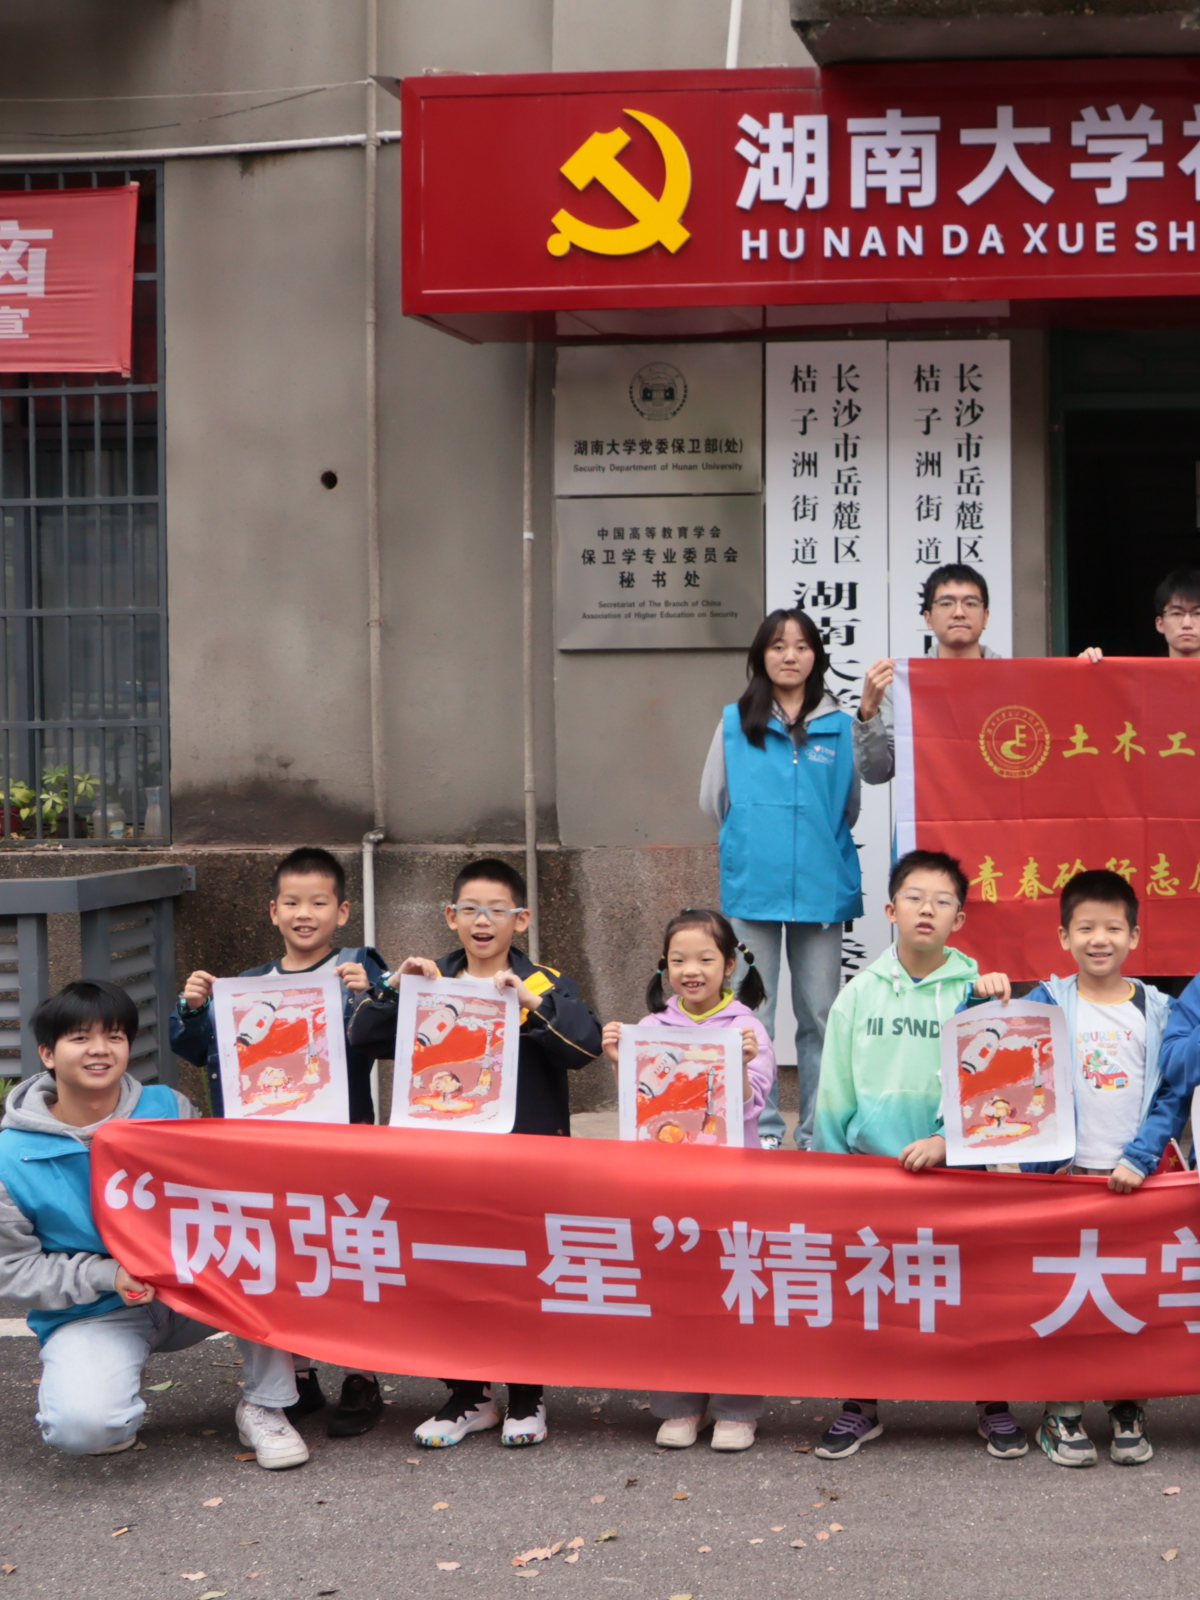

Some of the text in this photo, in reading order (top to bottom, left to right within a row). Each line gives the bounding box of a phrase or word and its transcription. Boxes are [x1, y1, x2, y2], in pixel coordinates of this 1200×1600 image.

[742, 228, 804, 259] HU
[824, 225, 922, 257] NAN
[943, 224, 1004, 254] DA
[1024, 222, 1115, 253] XUE
[573, 438, 744, 456] 湖南大学党委保卫部(处)
[790, 364, 819, 564] 桔子洲街道
[832, 363, 862, 564] 长沙市岳麓区
[913, 364, 942, 564] 桔子洲街道
[953, 363, 984, 565] 长沙市岳麓区
[573, 461, 743, 473] Security Department of Hunan University
[597, 525, 722, 541] 中国高等教育学会
[581, 546, 739, 565] 保卫学专业委员会
[618, 570, 701, 589] 秘书处
[104, 1166, 962, 1333] “两弹一星”精神
